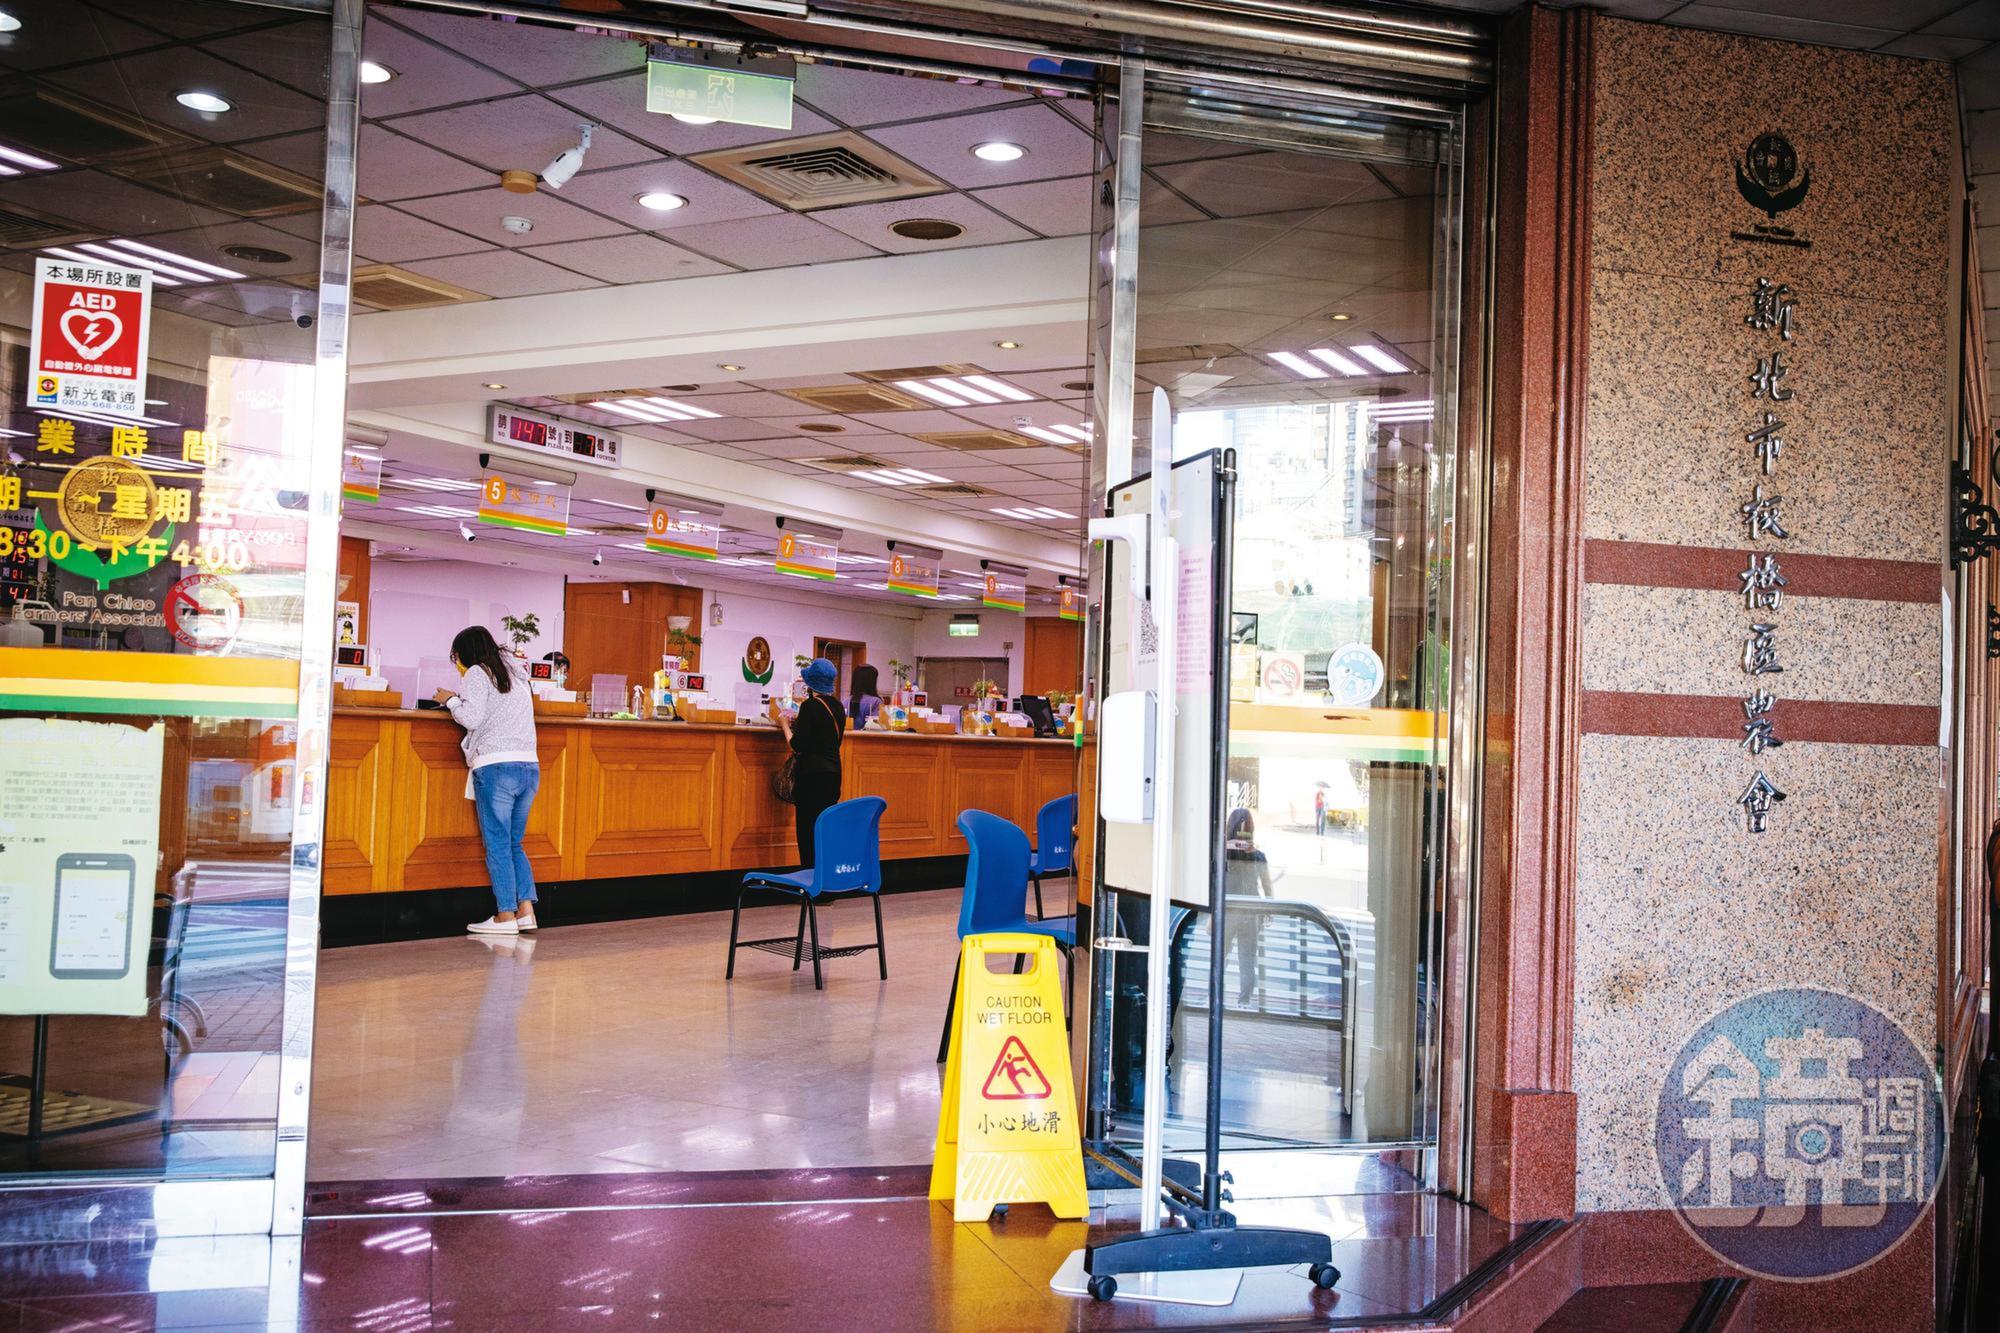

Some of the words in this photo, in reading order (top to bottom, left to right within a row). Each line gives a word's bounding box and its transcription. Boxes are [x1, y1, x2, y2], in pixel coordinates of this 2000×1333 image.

[46, 264, 141, 289] 本場所設置
[69, 291, 116, 311] AED
[62, 398, 136, 411] 0800-668-850
[63, 385, 136, 405] 新光電通
[515, 420, 546, 445] 147
[587, 434, 595, 457] 7
[491, 481, 501, 501] 5
[657, 513, 664, 530] 6
[784, 540, 792, 555] 7
[1739, 276, 1796, 834] 新北市板橋區農會
[894, 559, 901, 574] 8
[63, 591, 97, 608] Pan
[104, 593, 156, 611] Chiao
[986, 996, 1042, 1009] CAUTION
[977, 1012, 1005, 1025] WET
[1008, 1011, 1052, 1025] FLOOR
[978, 1110, 1061, 1135] 小心地滑
